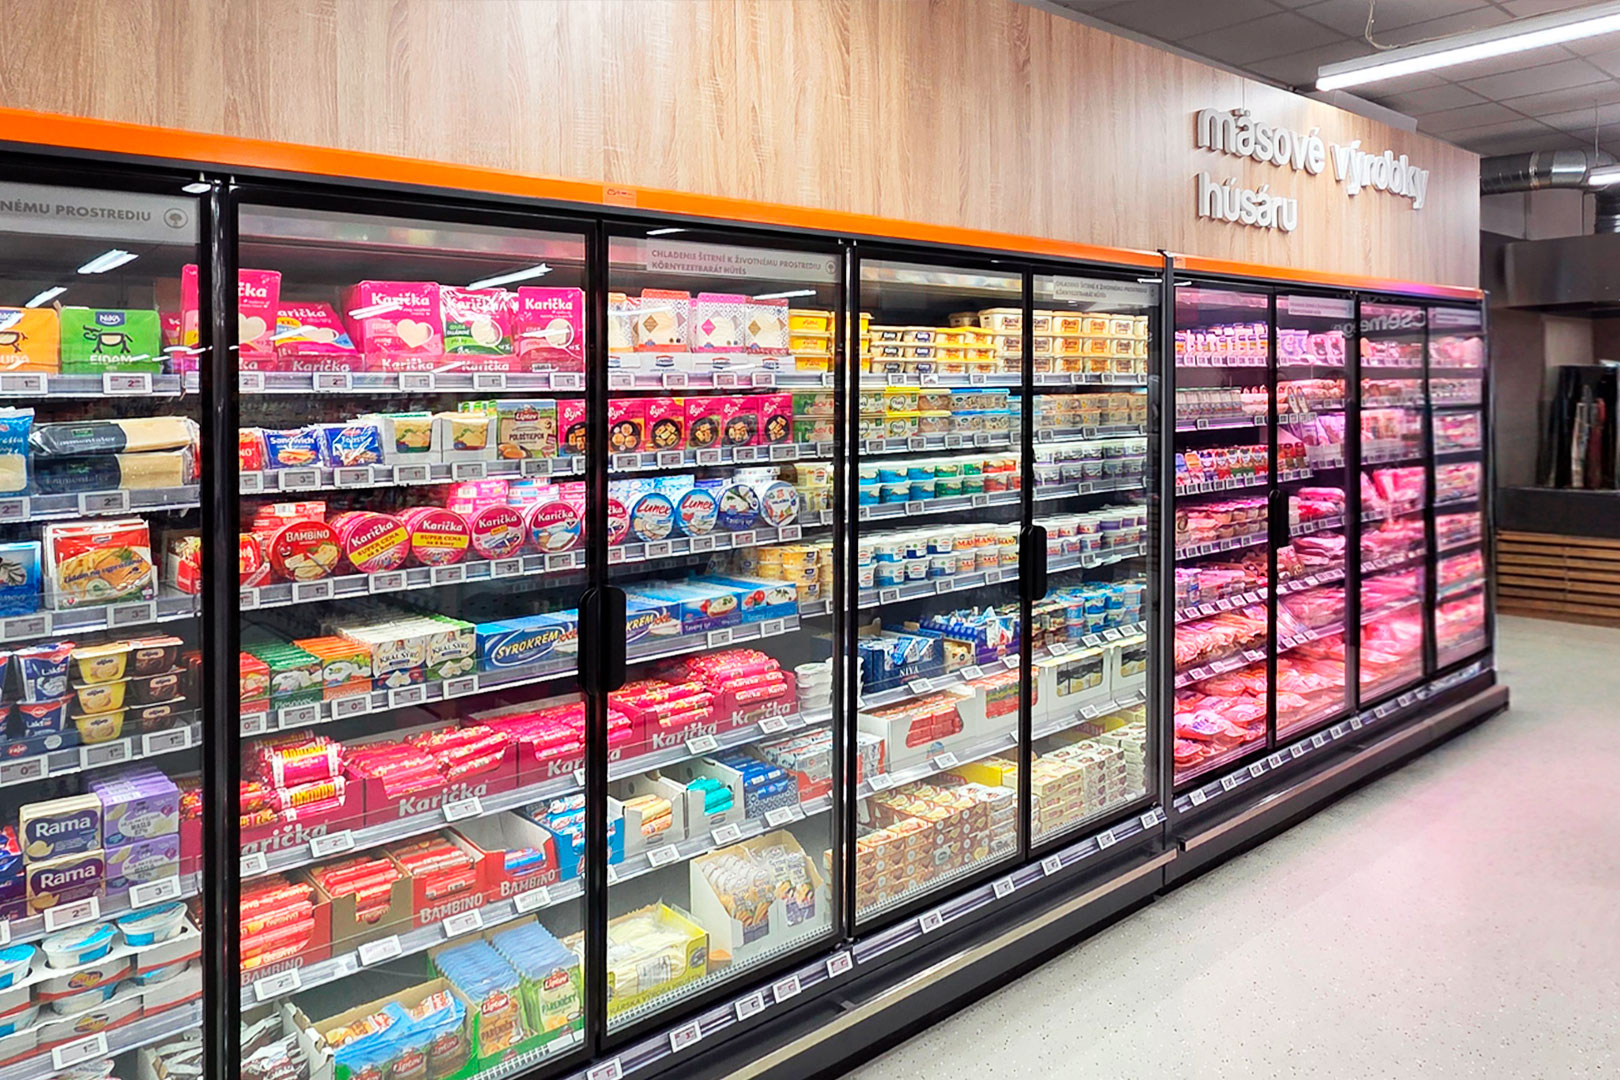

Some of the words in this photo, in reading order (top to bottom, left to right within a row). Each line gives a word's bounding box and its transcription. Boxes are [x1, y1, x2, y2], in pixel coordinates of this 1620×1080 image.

[1197, 107, 1326, 175] mäsové
[1330, 139, 1430, 210] výrobky
[1197, 171, 1298, 232] húsáru
[55, 204, 151, 222] PROSTREDIU
[779, 260, 821, 270] PROSTREDIU
[371, 292, 430, 306] Karička
[524, 298, 573, 310] Karička
[277, 309, 327, 318] arička
[292, 359, 350, 372] Karička
[381, 358, 434, 371] Karička
[478, 514, 518, 529] Karička
[537, 510, 574, 522] Karička
[350, 521, 395, 548] Karička
[422, 520, 463, 532] Karička
[285, 529, 330, 543] BAMBINO
[652, 721, 718, 750] Karička
[399, 781, 488, 817] Karička
[35, 816, 92, 837] Rama
[241, 823, 328, 856] arička
[40, 864, 97, 888] Rama
[500, 868, 556, 897] BAMBINO
[420, 892, 483, 924] BAMBINO
